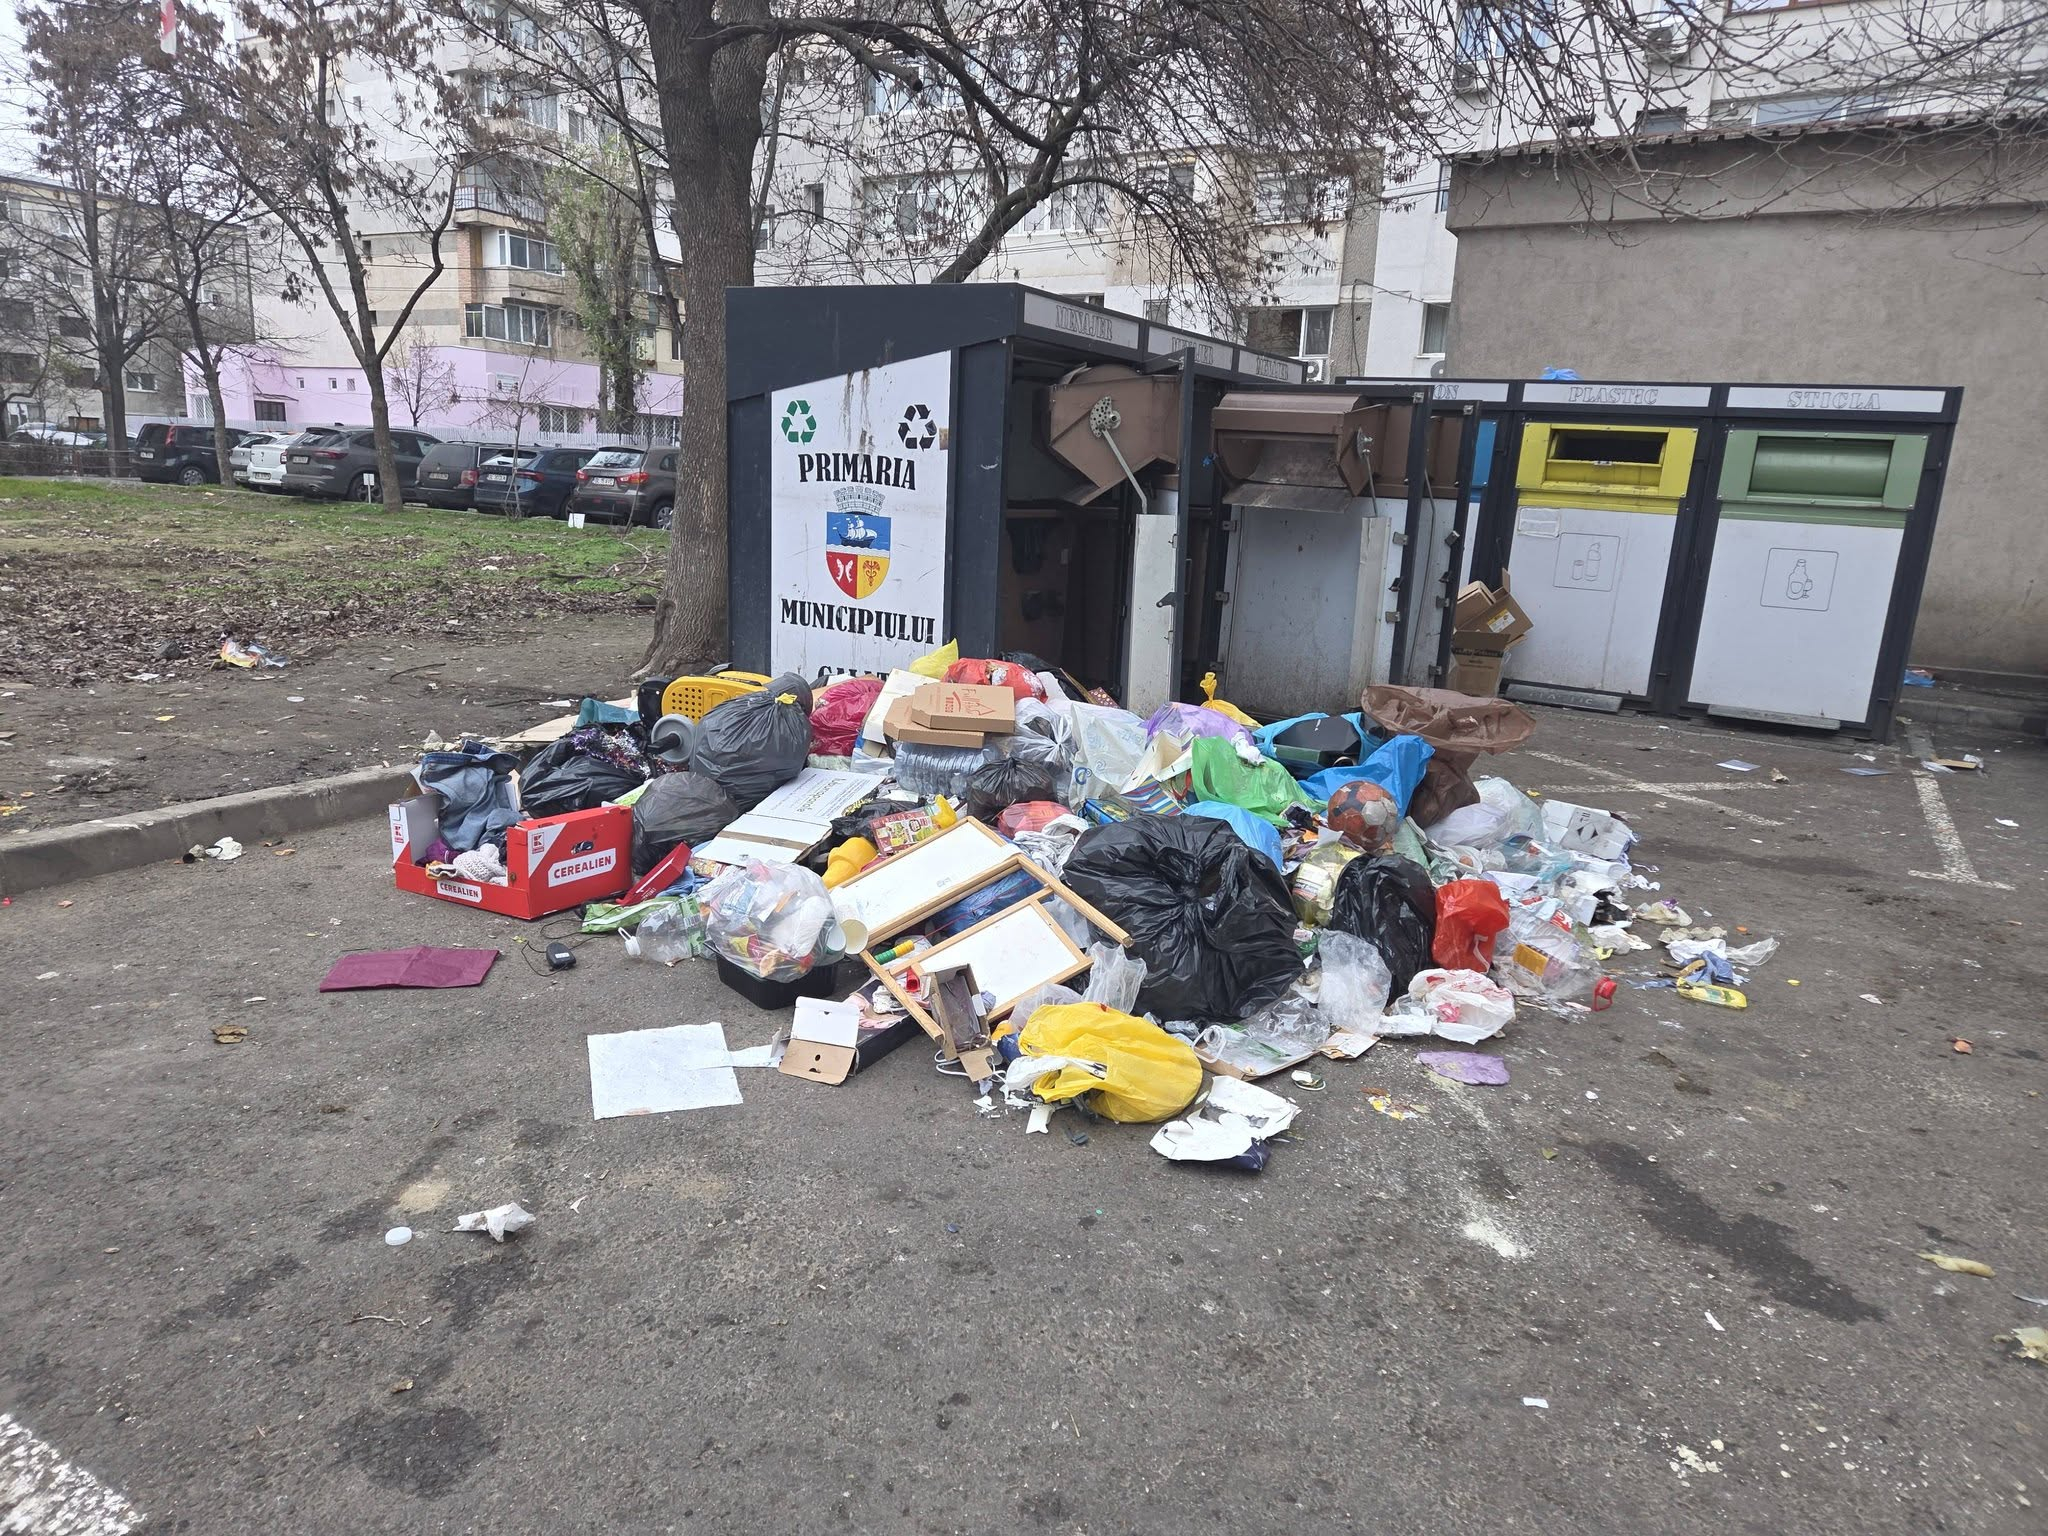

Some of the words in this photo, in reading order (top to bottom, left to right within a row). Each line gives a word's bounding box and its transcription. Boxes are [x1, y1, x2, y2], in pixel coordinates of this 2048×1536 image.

[1055, 304, 1113, 341] MENAJER
[1568, 386, 1659, 405] PLASTIC
[1786, 390, 1881, 410] STICLA
[798, 452, 917, 491] PRIMARIA
[781, 598, 936, 645] MUNICIPIULUI
[553, 856, 612, 879] CEREALIEN
[439, 882, 479, 899] CEREALIEN
